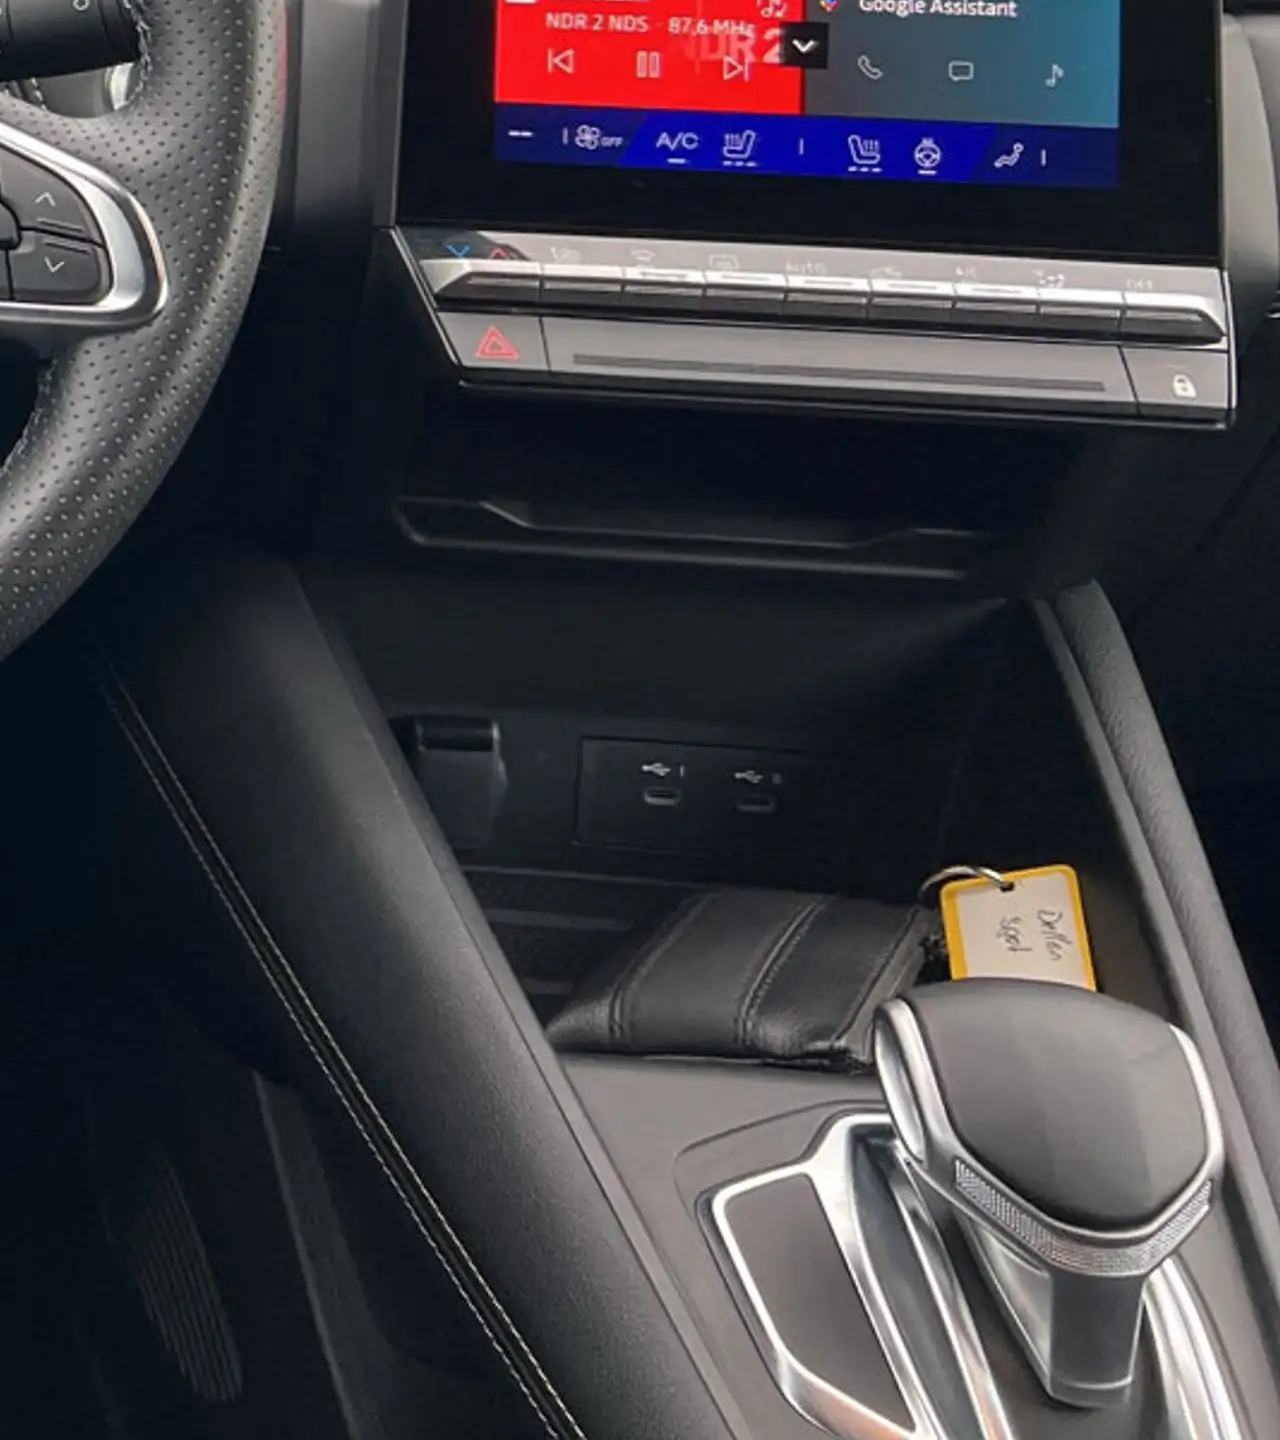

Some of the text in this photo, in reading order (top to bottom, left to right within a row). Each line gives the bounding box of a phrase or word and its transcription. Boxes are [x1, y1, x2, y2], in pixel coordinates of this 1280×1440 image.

[544, 12, 591, 31] NDR
[592, 14, 605, 31] 2
[607, 15, 650, 34] NDS
[655, 131, 700, 150] A/C
